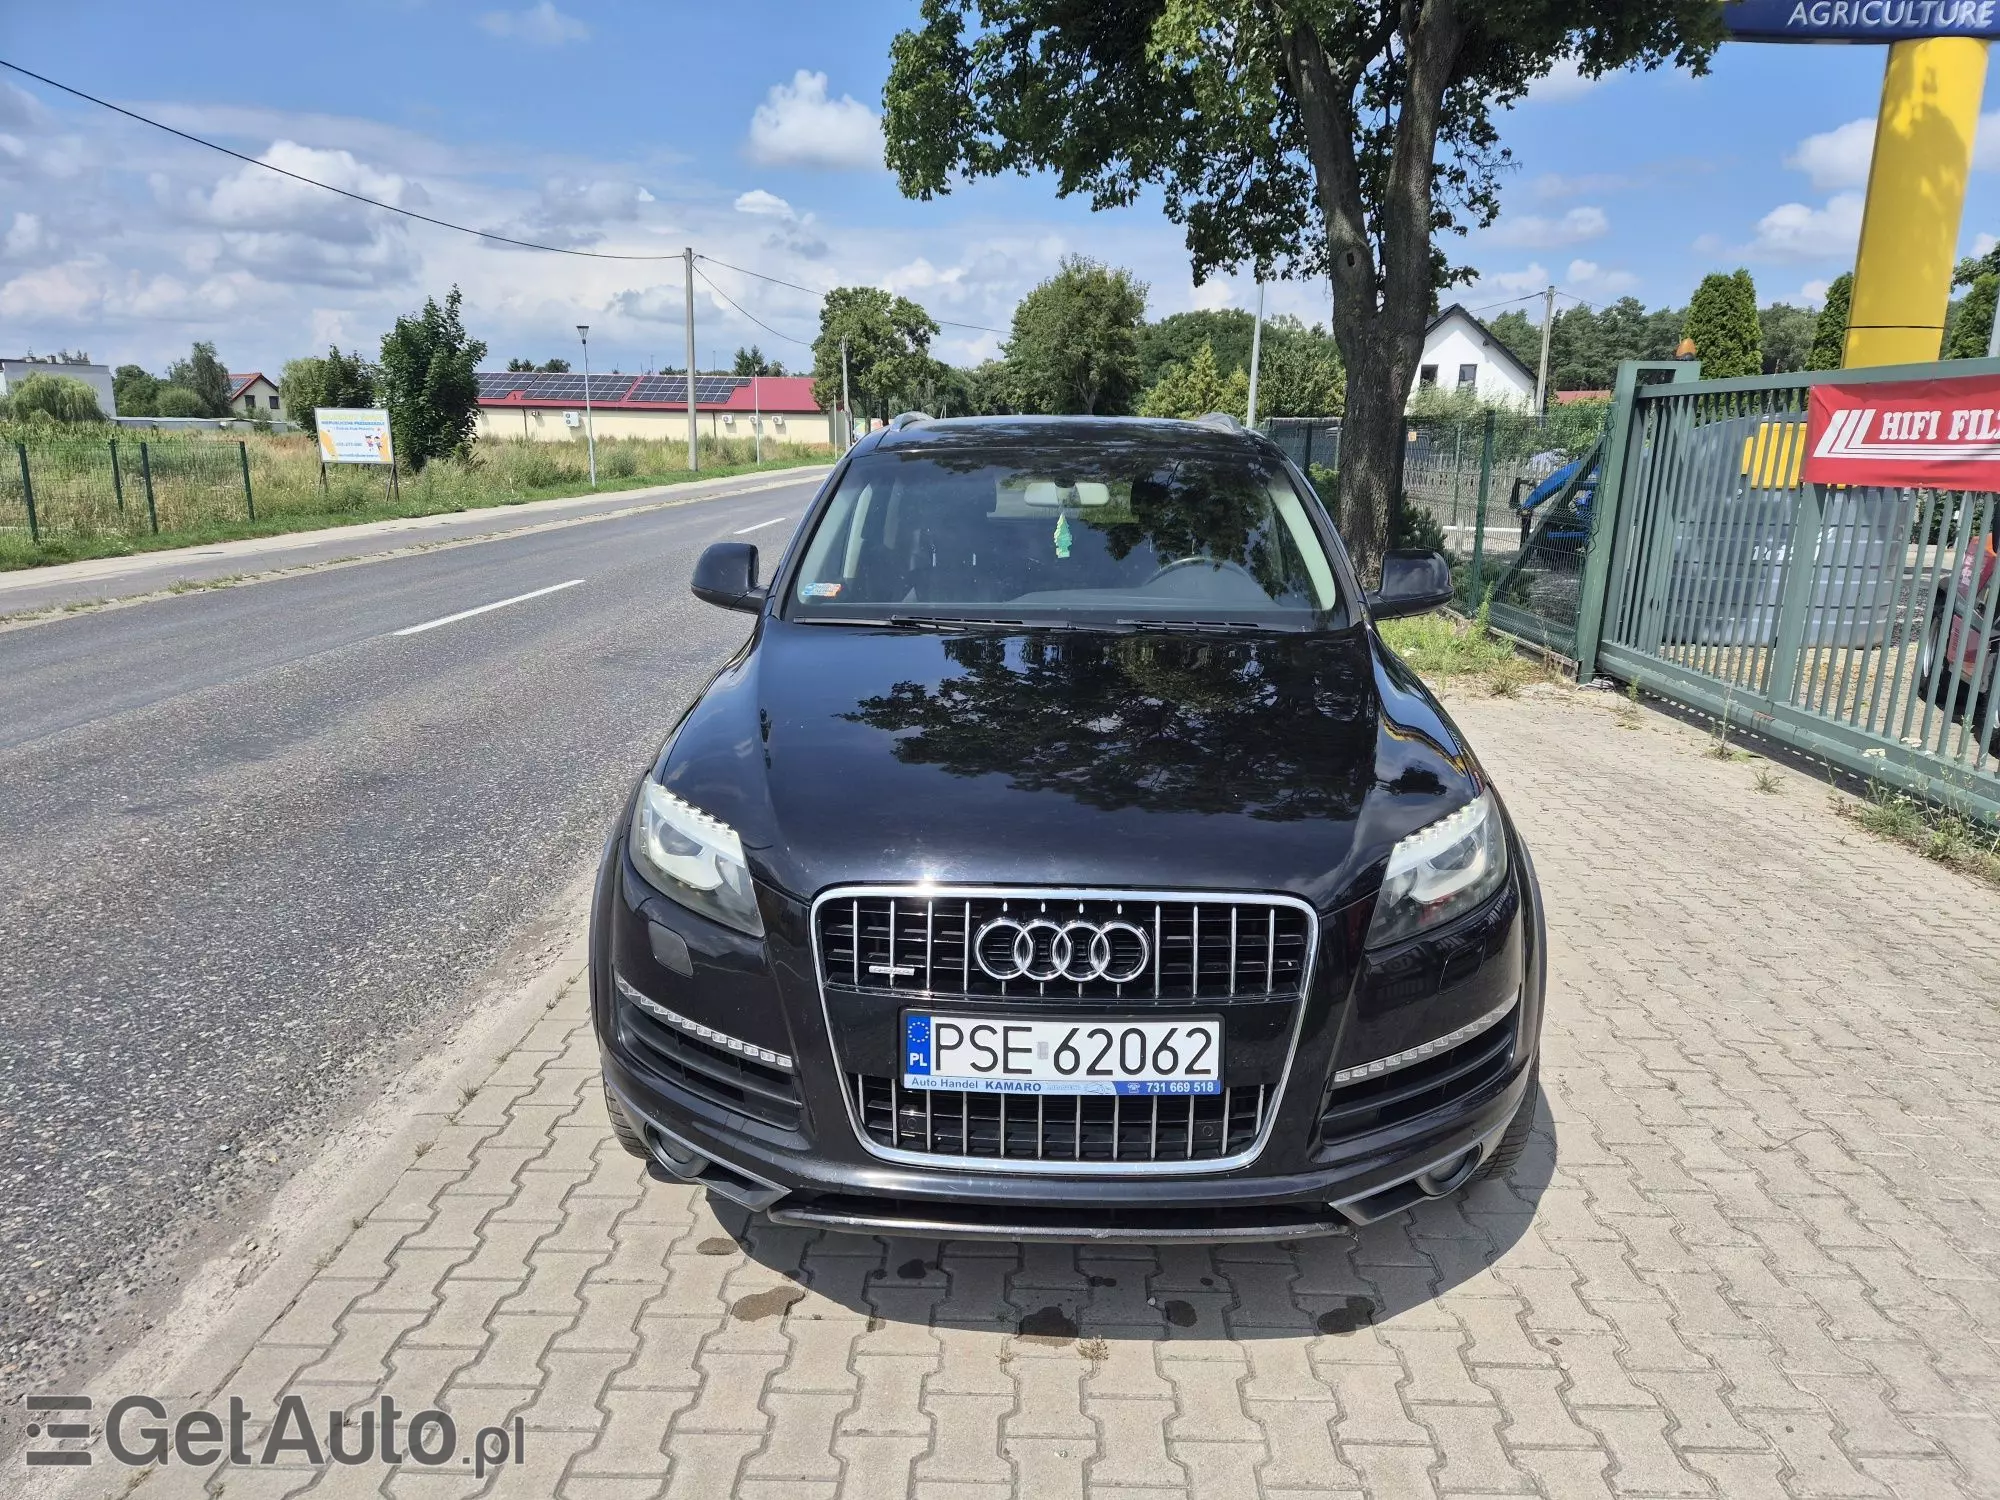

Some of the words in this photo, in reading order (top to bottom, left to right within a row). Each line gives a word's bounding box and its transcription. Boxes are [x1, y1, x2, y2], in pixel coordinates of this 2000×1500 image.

[1786, 0, 1994, 28] AGRICULTURE
[1879, 410, 1942, 441] HIFI
[909, 1052, 928, 1067] PL
[934, 1022, 1033, 1076] PSE
[1053, 1027, 1212, 1077] 62062
[911, 1077, 937, 1087] Auto
[940, 1078, 978, 1090] Handel
[985, 1081, 1042, 1092] KAMARO
[1146, 1082, 1166, 1093] 731
[1169, 1082, 1191, 1093] 669
[1193, 1081, 1214, 1093] 518
